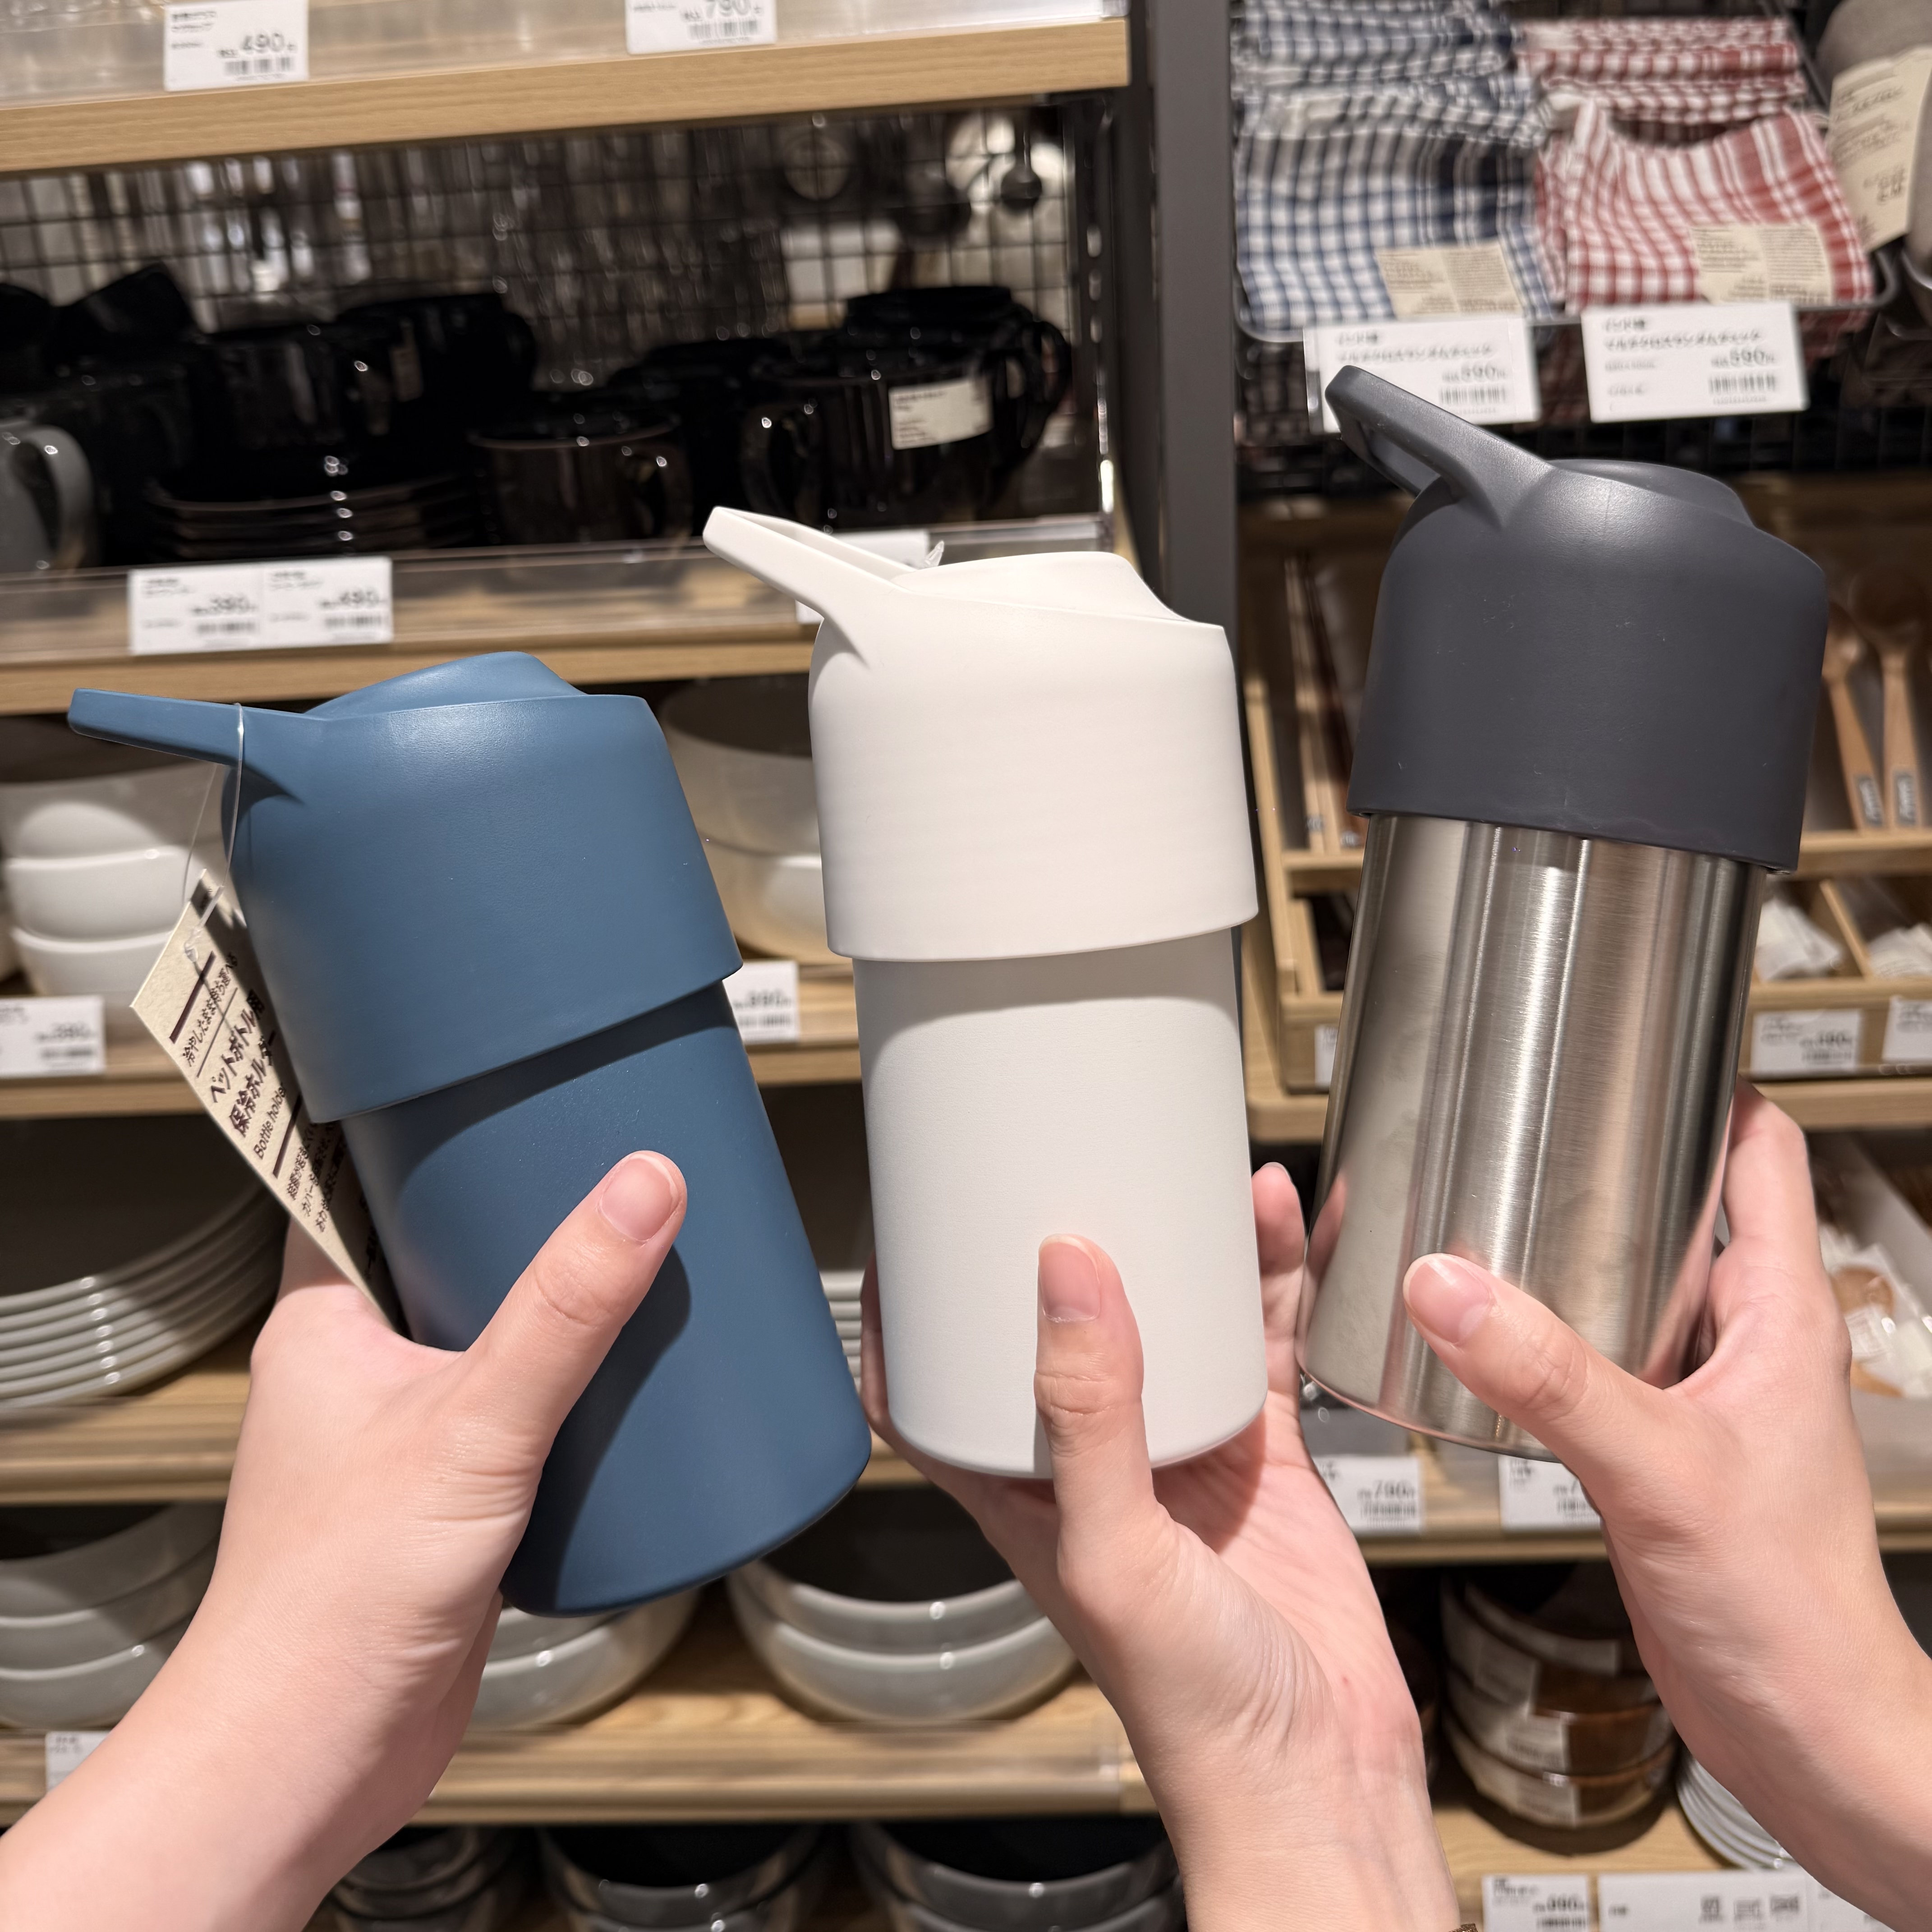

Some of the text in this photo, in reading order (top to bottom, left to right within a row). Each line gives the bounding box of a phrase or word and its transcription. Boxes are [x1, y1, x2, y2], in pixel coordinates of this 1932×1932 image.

[206, 989, 265, 1103] ペットボトル用
[228, 1027, 276, 1138] 保冷ホルダー
[253, 1082, 287, 1160] Bottle holder
